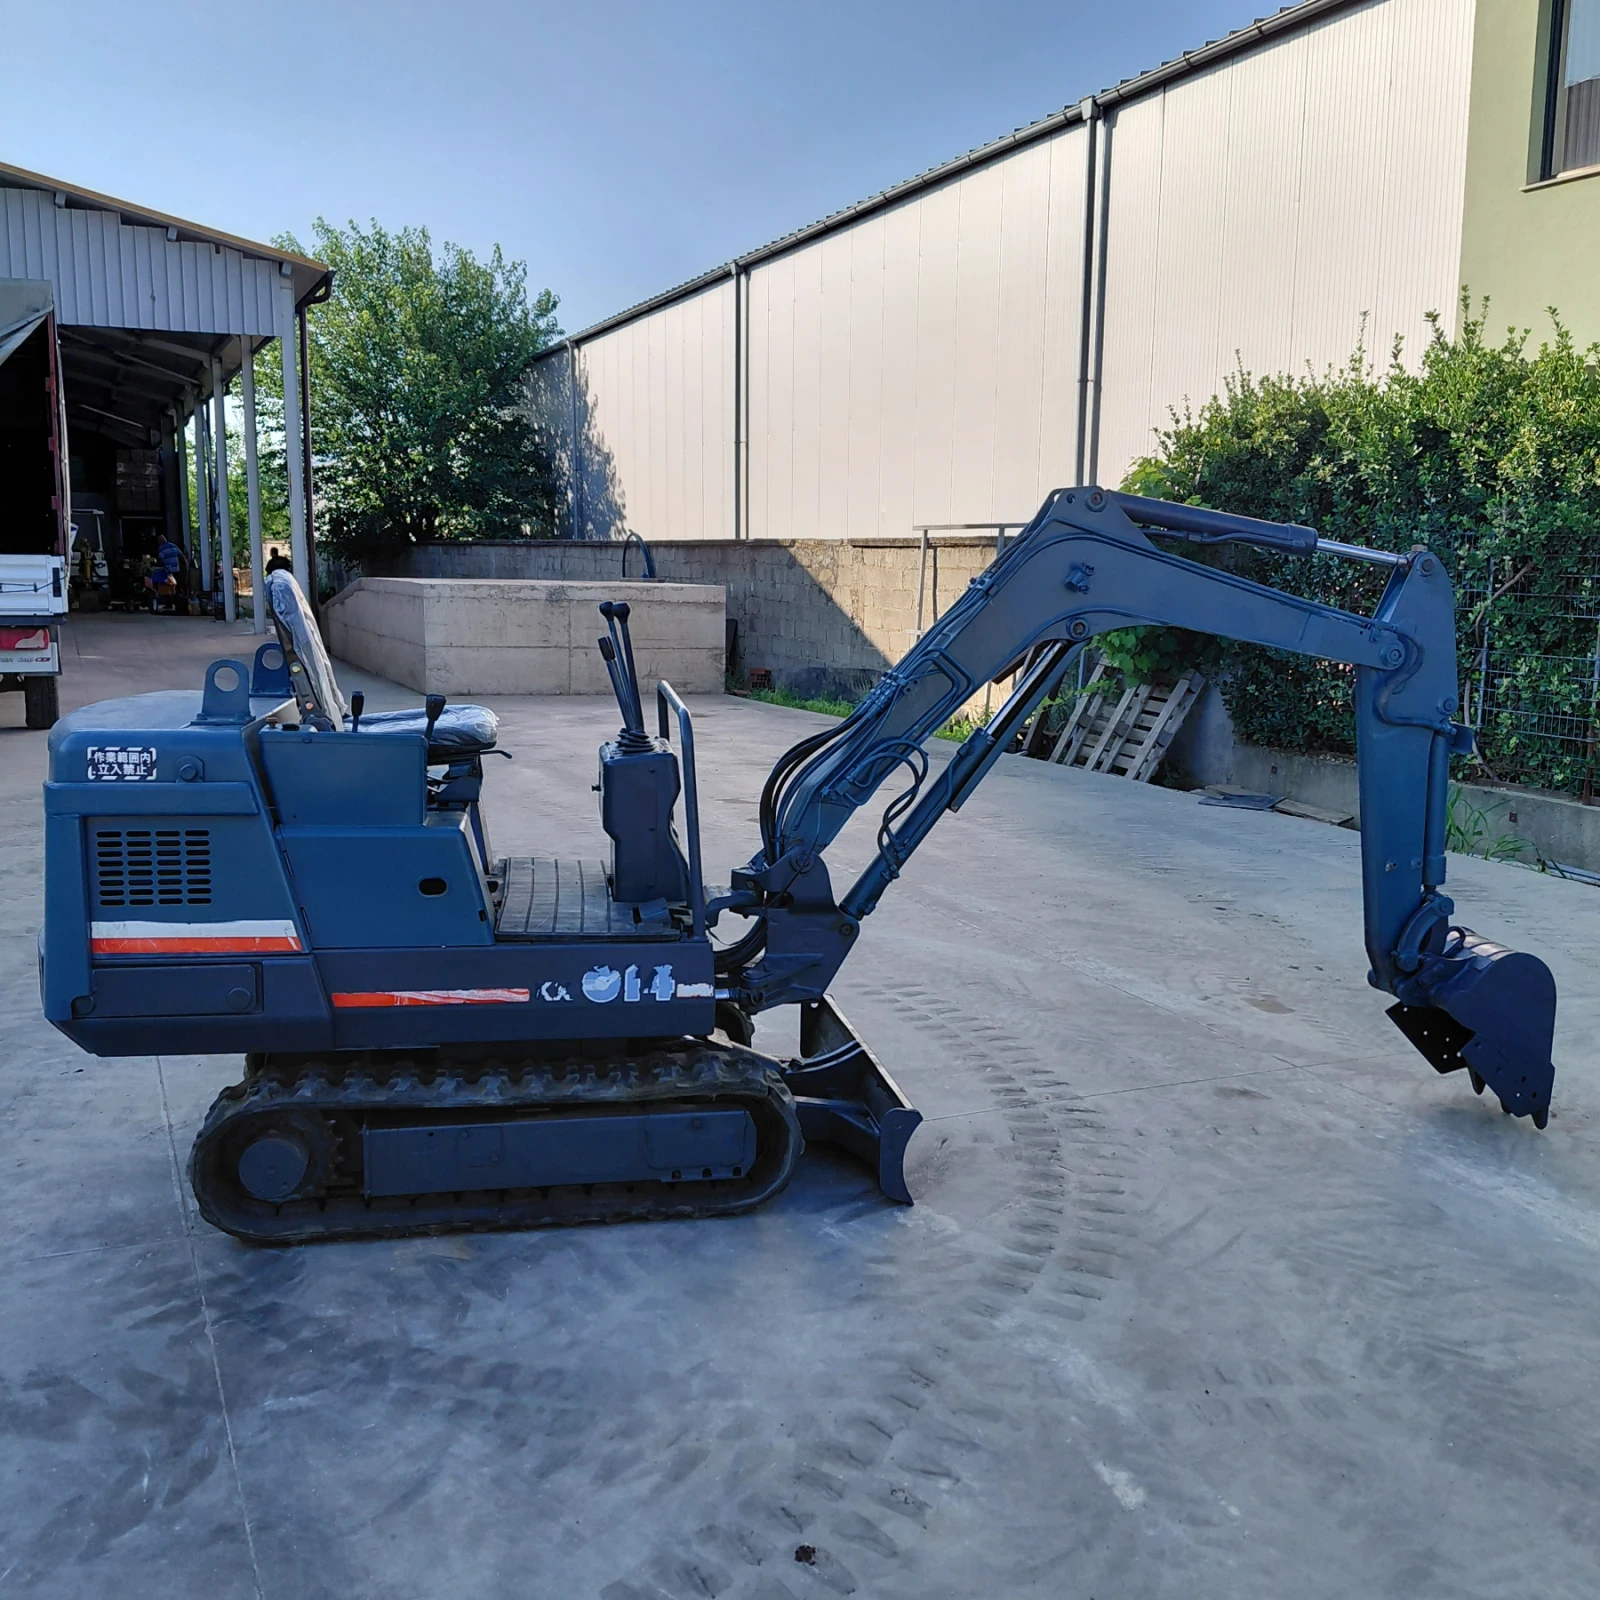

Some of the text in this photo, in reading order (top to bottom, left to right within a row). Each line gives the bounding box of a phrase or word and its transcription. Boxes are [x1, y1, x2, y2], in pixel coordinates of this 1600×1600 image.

[93, 751, 151, 764] 作業範囲内
[97, 764, 148, 775] 立入禁止
